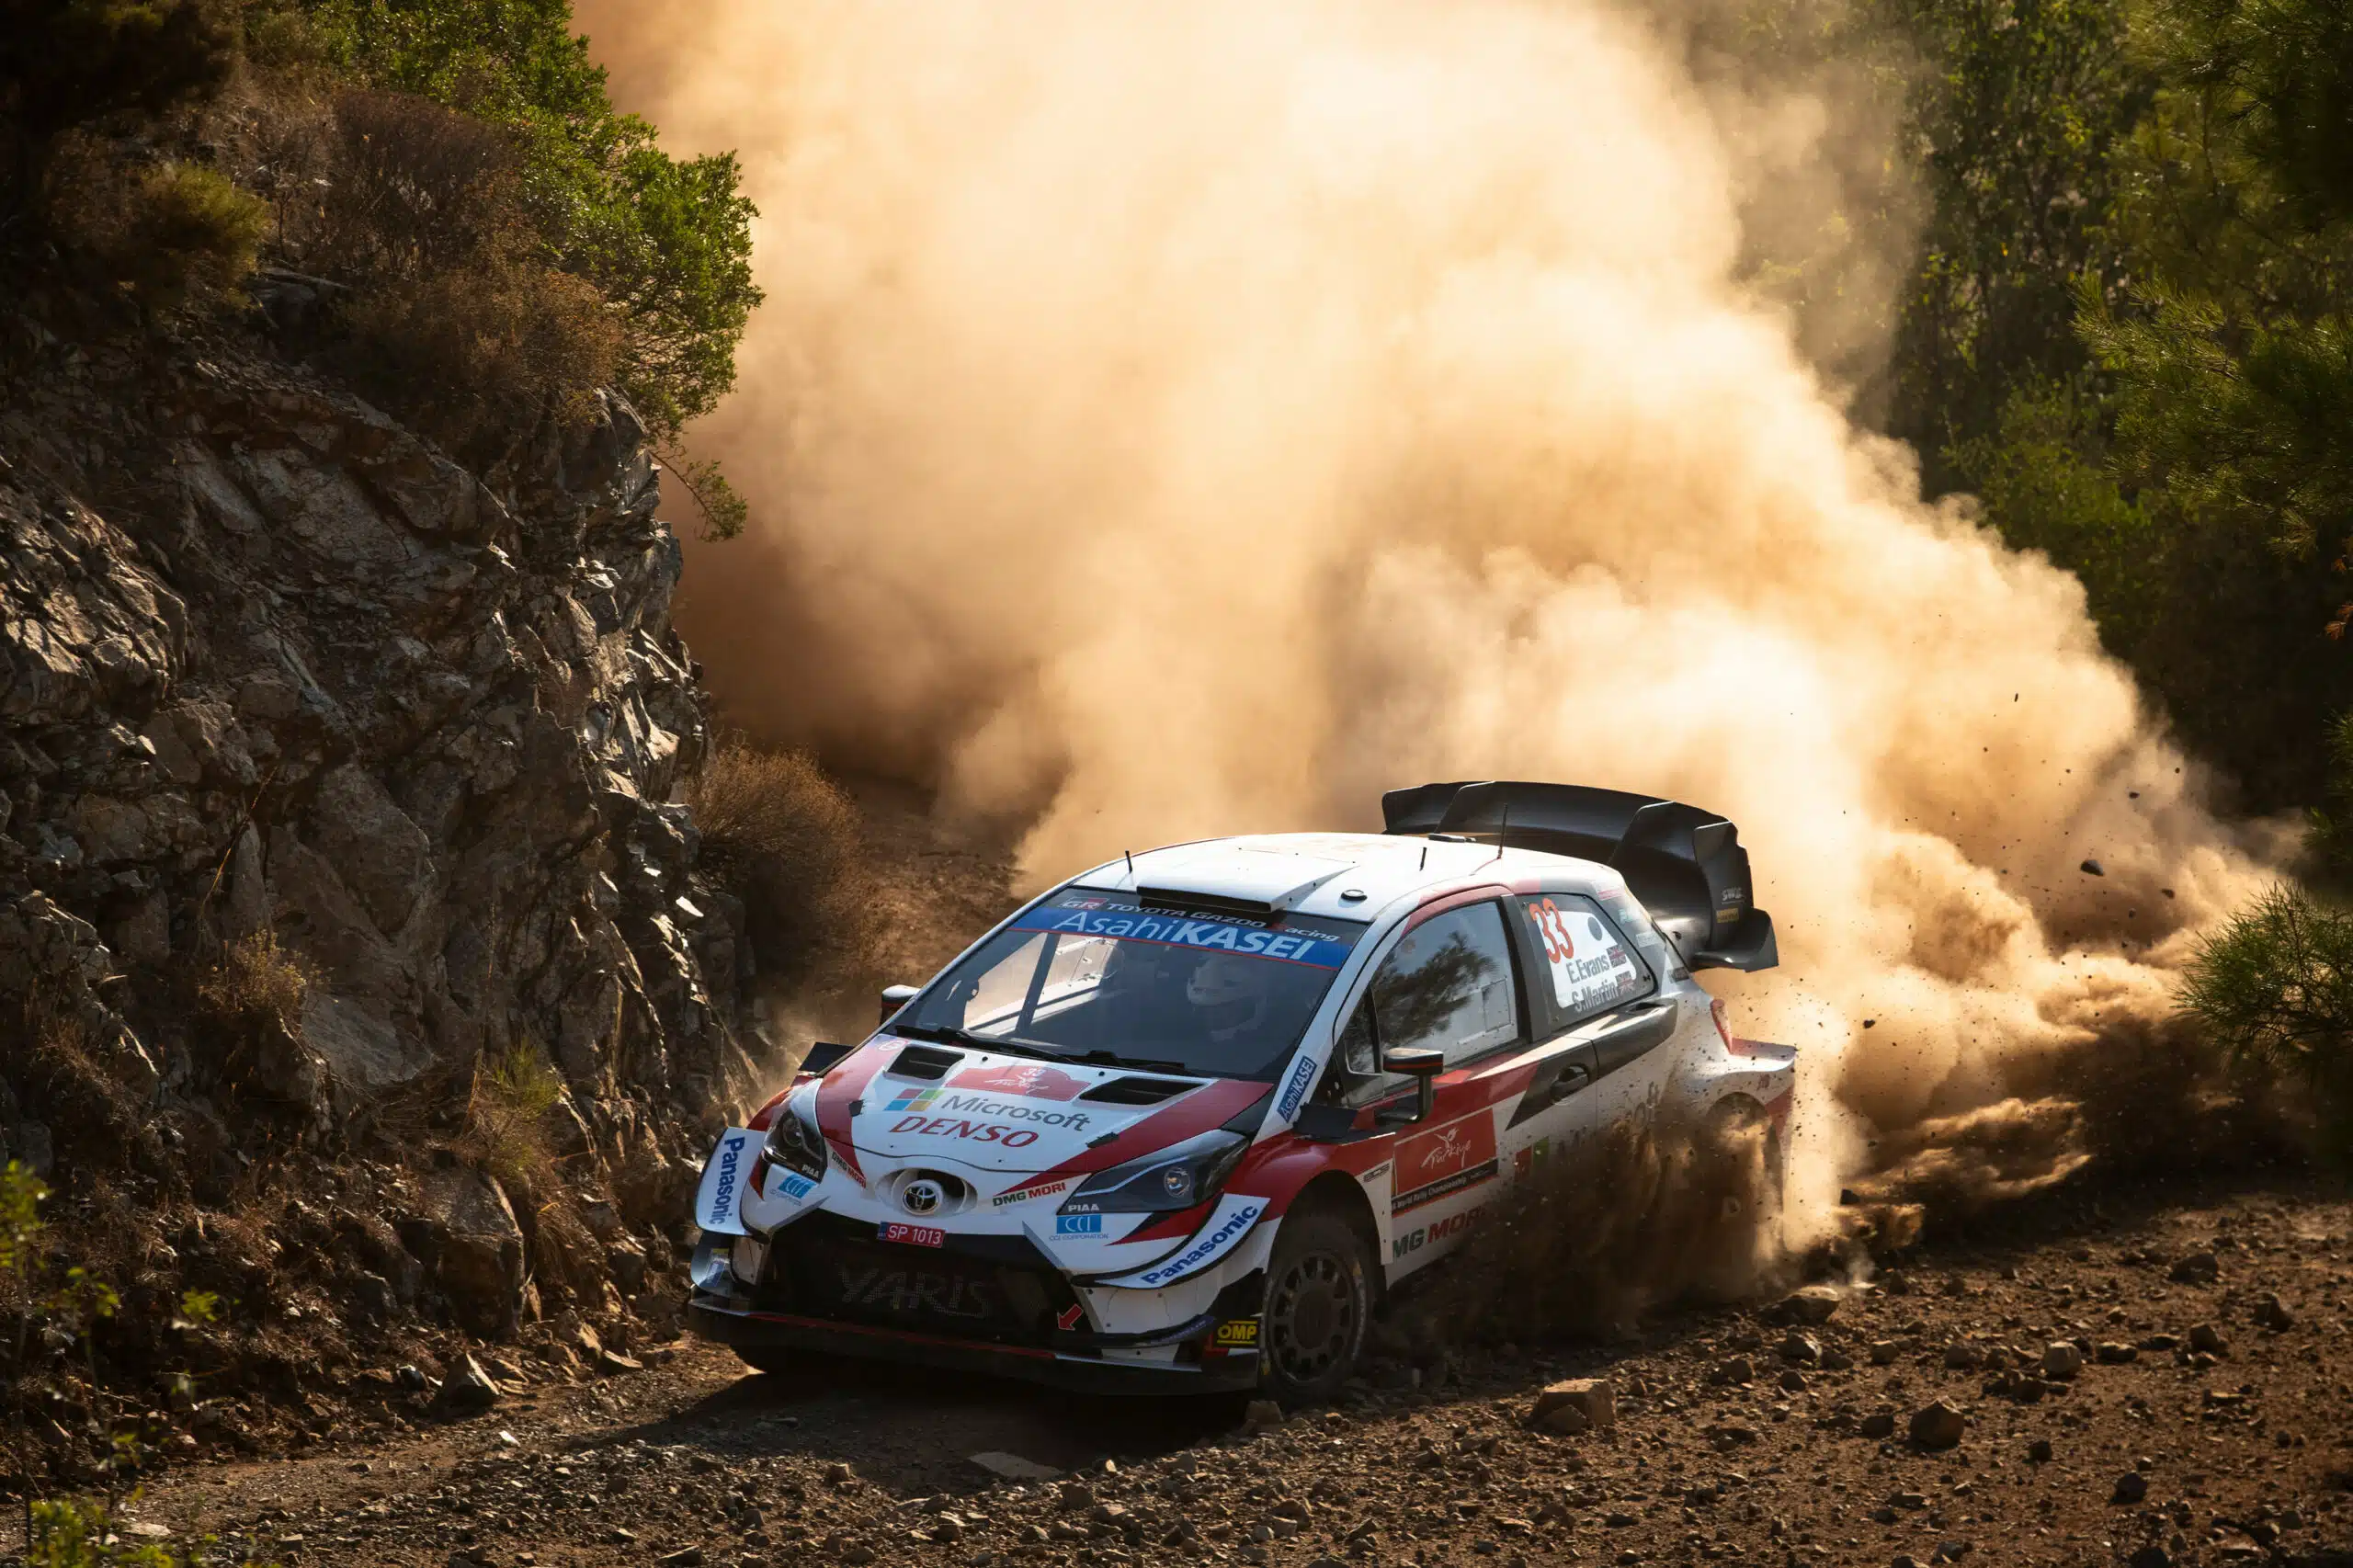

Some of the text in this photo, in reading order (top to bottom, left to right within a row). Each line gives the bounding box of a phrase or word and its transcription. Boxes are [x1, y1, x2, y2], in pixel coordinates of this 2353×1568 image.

[1107, 903, 1186, 917] TOYOTA
[1051, 910, 1317, 960] AsahiKASEI
[1529, 897, 1574, 964] 33
[1565, 952, 1610, 985] E.Evans
[1571, 979, 1620, 1013] S.Martin
[1279, 1058, 1315, 1119] AsahiKASEI
[940, 1095, 1091, 1132] Microsoft
[888, 1116, 1040, 1148] DENSO
[708, 1136, 746, 1225] Panasonic
[801, 1165, 820, 1179] PIAA
[992, 1182, 1067, 1207] DMG MORI
[1068, 1203, 1100, 1212] PIAA
[888, 1224, 909, 1240] SP
[912, 1228, 942, 1244] 1013
[1140, 1205, 1258, 1285] Panasonic
[1392, 1228, 1426, 1258] MG
[1217, 1323, 1257, 1339] OMP
